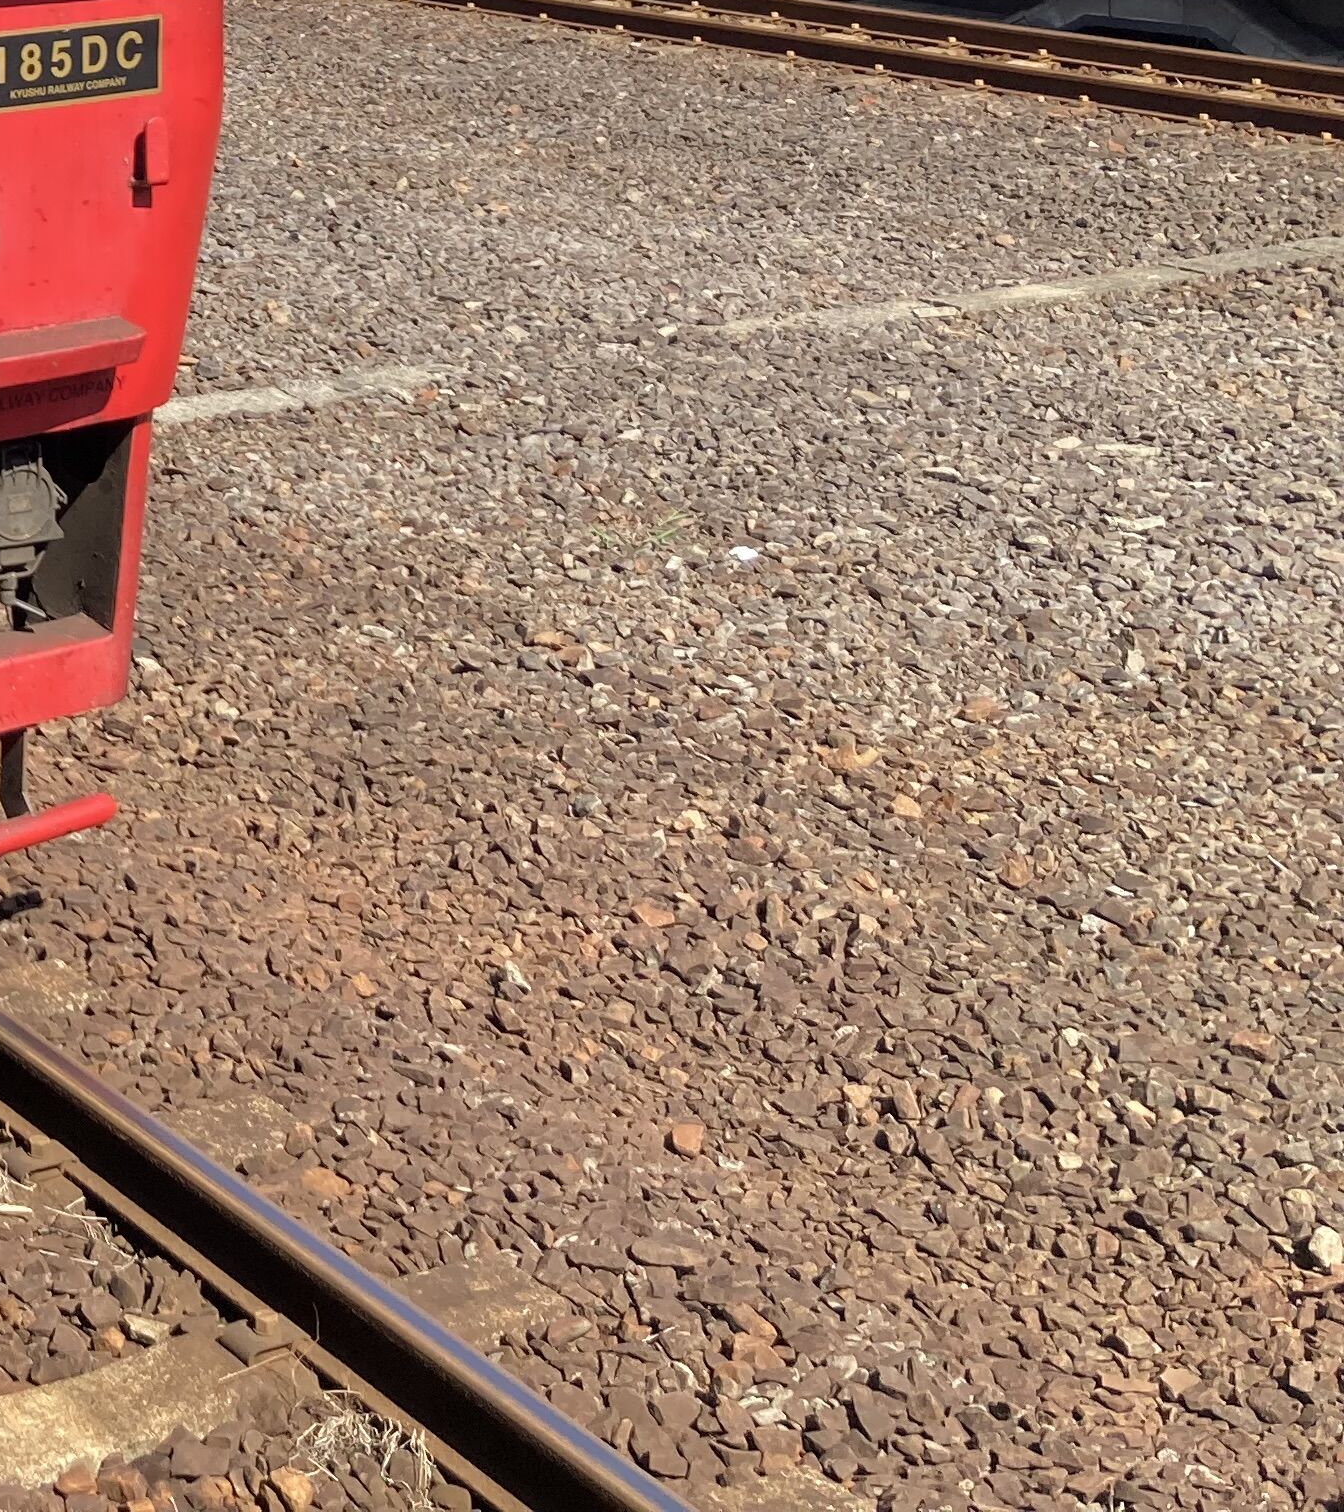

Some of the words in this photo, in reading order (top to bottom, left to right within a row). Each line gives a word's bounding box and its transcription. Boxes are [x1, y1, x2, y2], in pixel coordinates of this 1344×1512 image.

[10, 85, 46, 100] KYUSHU
[47, 81, 86, 95] RAILWAY
[86, 76, 127, 90] COMPANY
[48, 375, 125, 401] COMPANY
